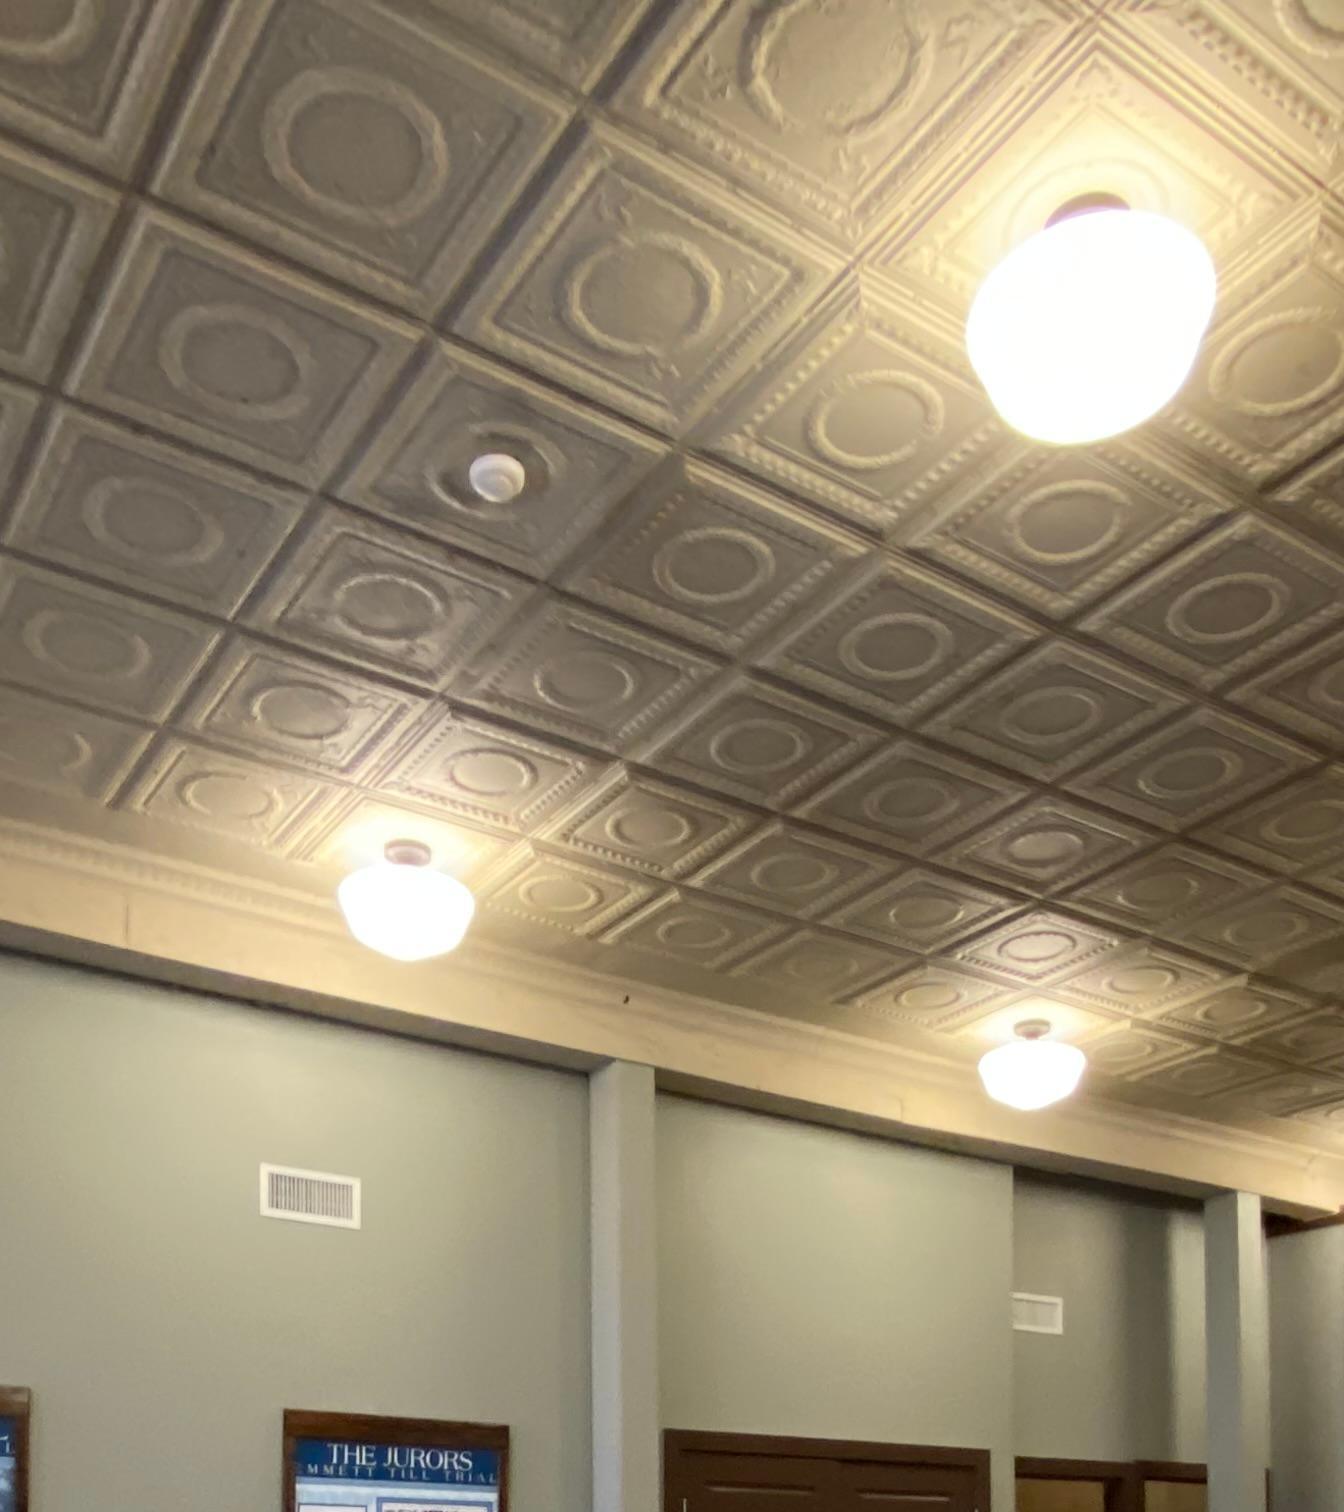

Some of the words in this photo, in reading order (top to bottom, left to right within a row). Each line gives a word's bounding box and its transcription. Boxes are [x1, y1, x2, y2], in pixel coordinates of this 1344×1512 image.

[327, 1442, 377, 1466] THE
[383, 1446, 474, 1472] JURORS
[387, 1467, 431, 1480] TILL
[444, 1470, 497, 1484] TRIAL
